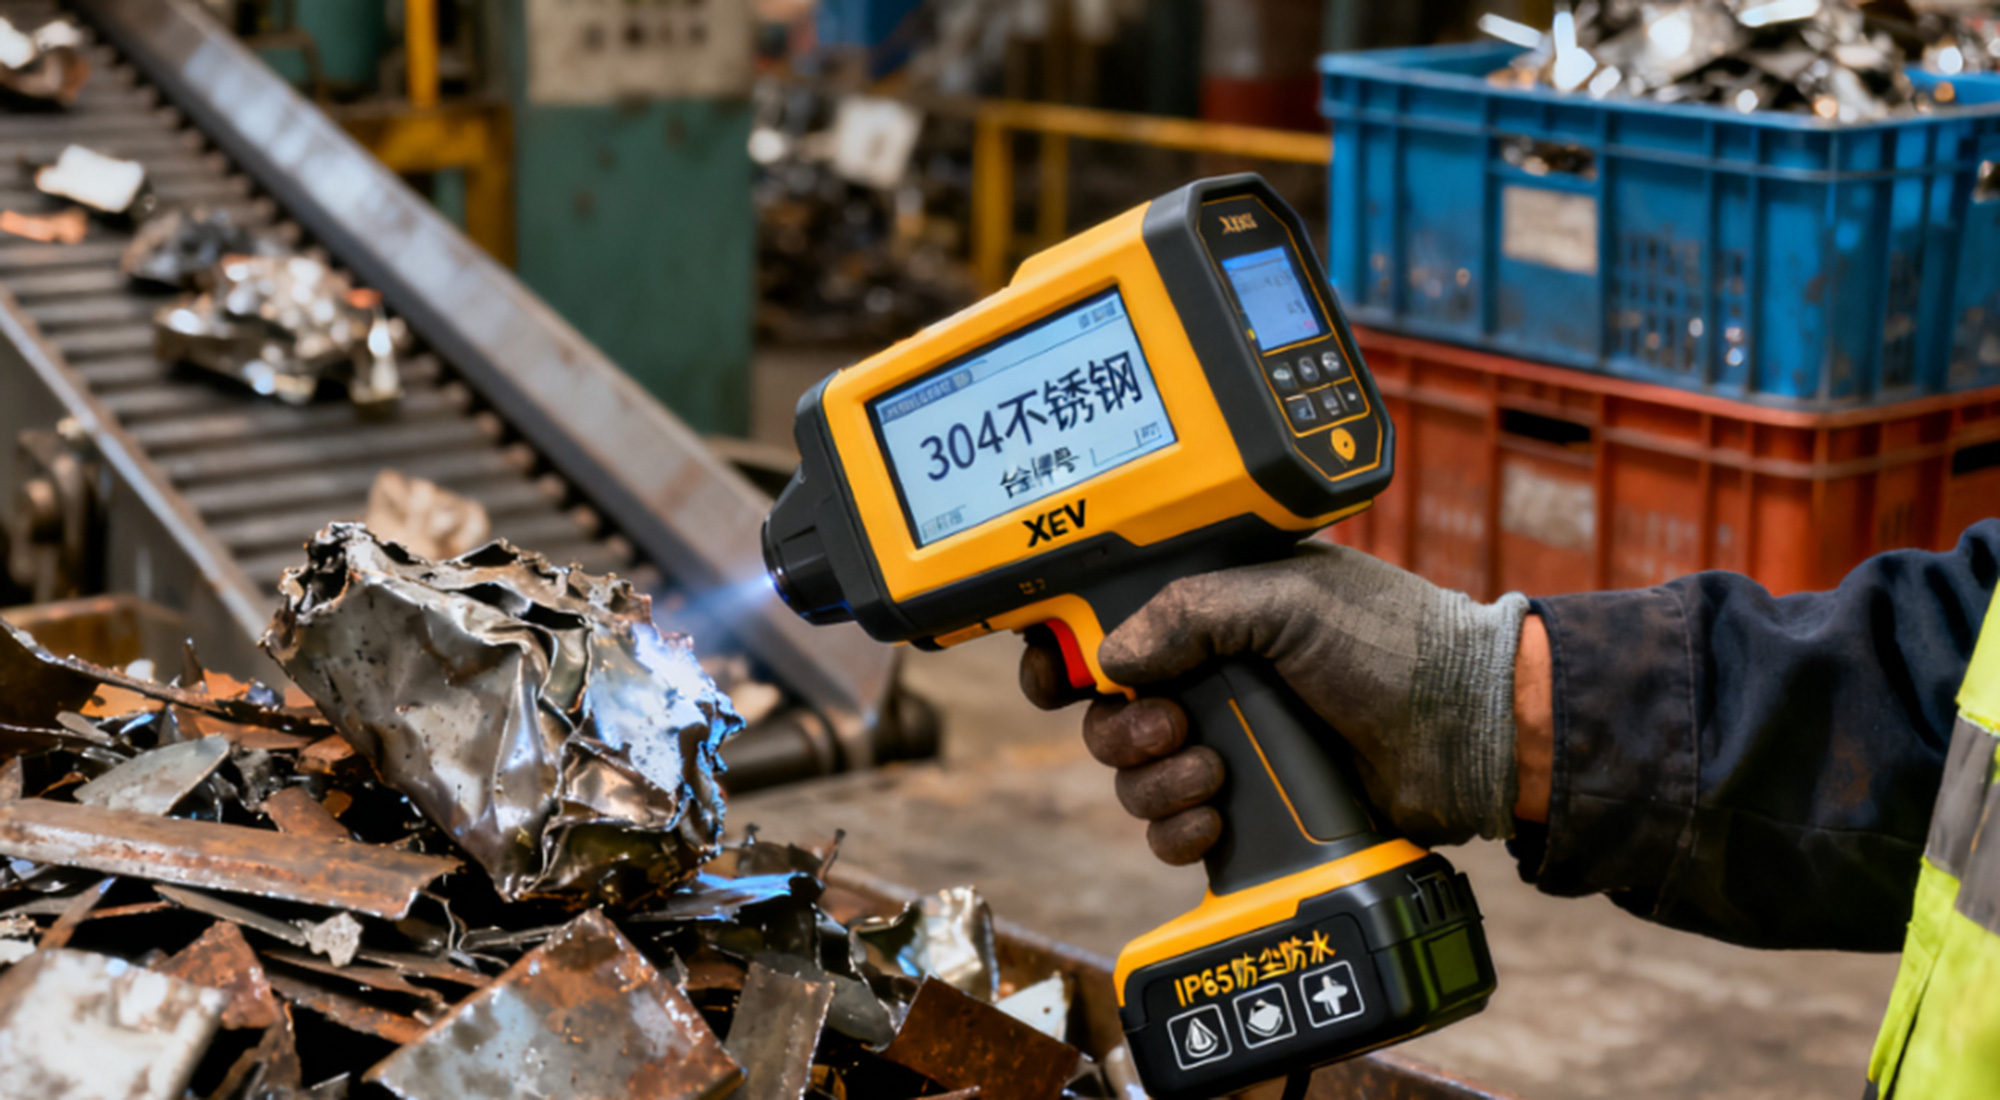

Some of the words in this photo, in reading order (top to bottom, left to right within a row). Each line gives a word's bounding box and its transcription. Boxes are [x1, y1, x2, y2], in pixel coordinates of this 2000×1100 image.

[920, 351, 1142, 482] 304不锈钢
[1022, 499, 1087, 548] XEV
